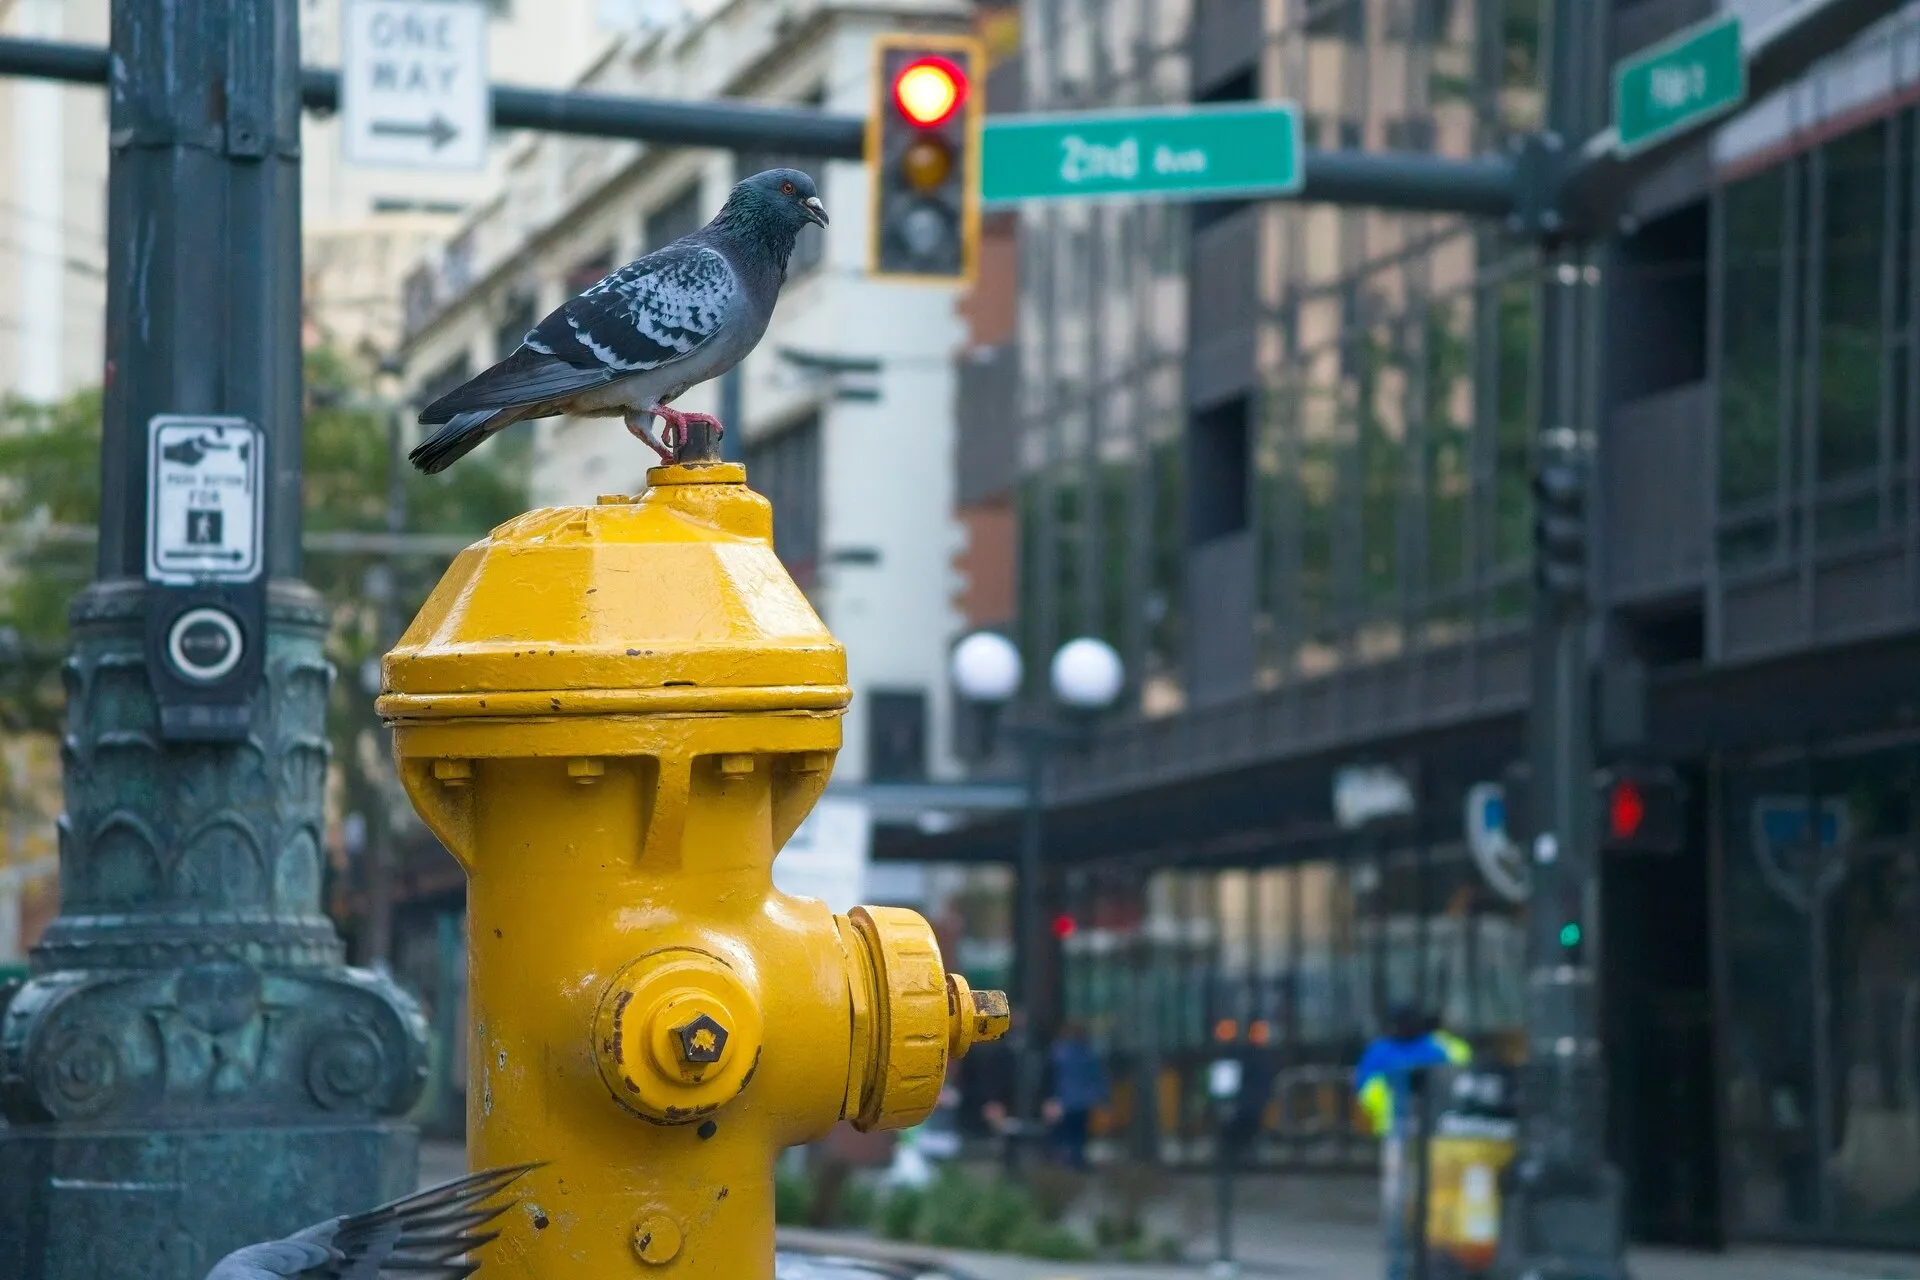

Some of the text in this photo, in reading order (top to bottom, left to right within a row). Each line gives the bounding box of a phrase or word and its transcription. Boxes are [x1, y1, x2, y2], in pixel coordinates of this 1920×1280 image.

[367, 11, 458, 50] ONE
[367, 60, 461, 94] WAY
[1060, 136, 1138, 182] 2nd
